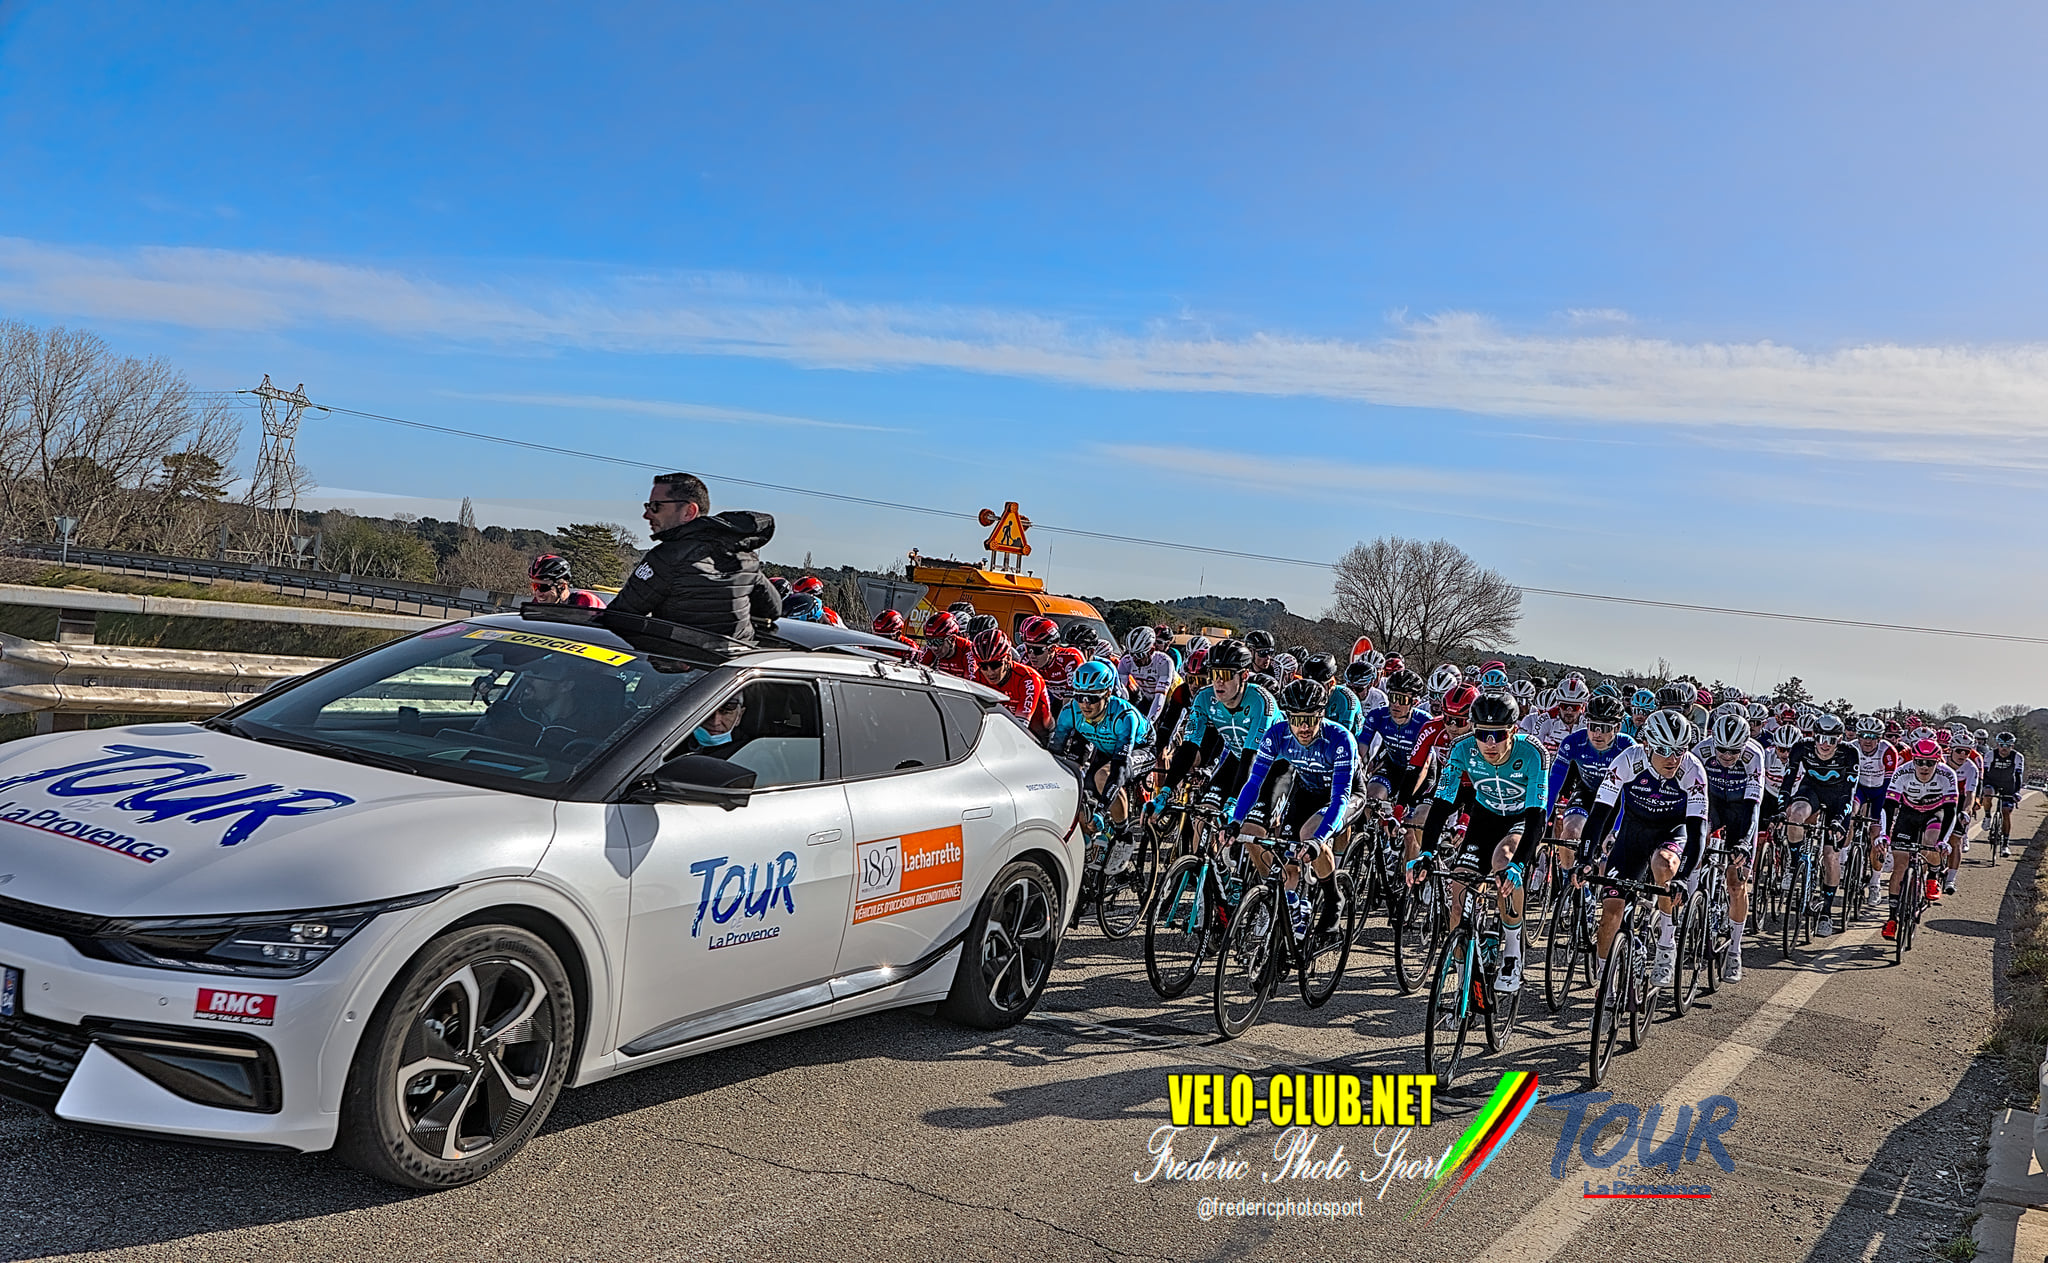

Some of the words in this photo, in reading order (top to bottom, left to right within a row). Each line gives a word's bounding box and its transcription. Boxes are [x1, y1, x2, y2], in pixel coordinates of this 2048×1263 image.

[511, 634, 589, 654] OFFICIEL
[1022, 679, 1036, 714] ARKEA
[1411, 726, 1436, 757] SOUDAL
[0, 744, 357, 847] TOUR
[27, 808, 170, 862] Provence
[904, 842, 961, 872] Lacharrette
[690, 851, 798, 938] TOUR
[855, 905, 884, 920] VÉHICULES
[884, 896, 915, 913] D'OCCASION
[915, 883, 961, 904] RECONDITIONNÉS
[709, 936, 724, 948] La
[726, 926, 780, 945] Provence
[209, 992, 264, 1015] RMC
